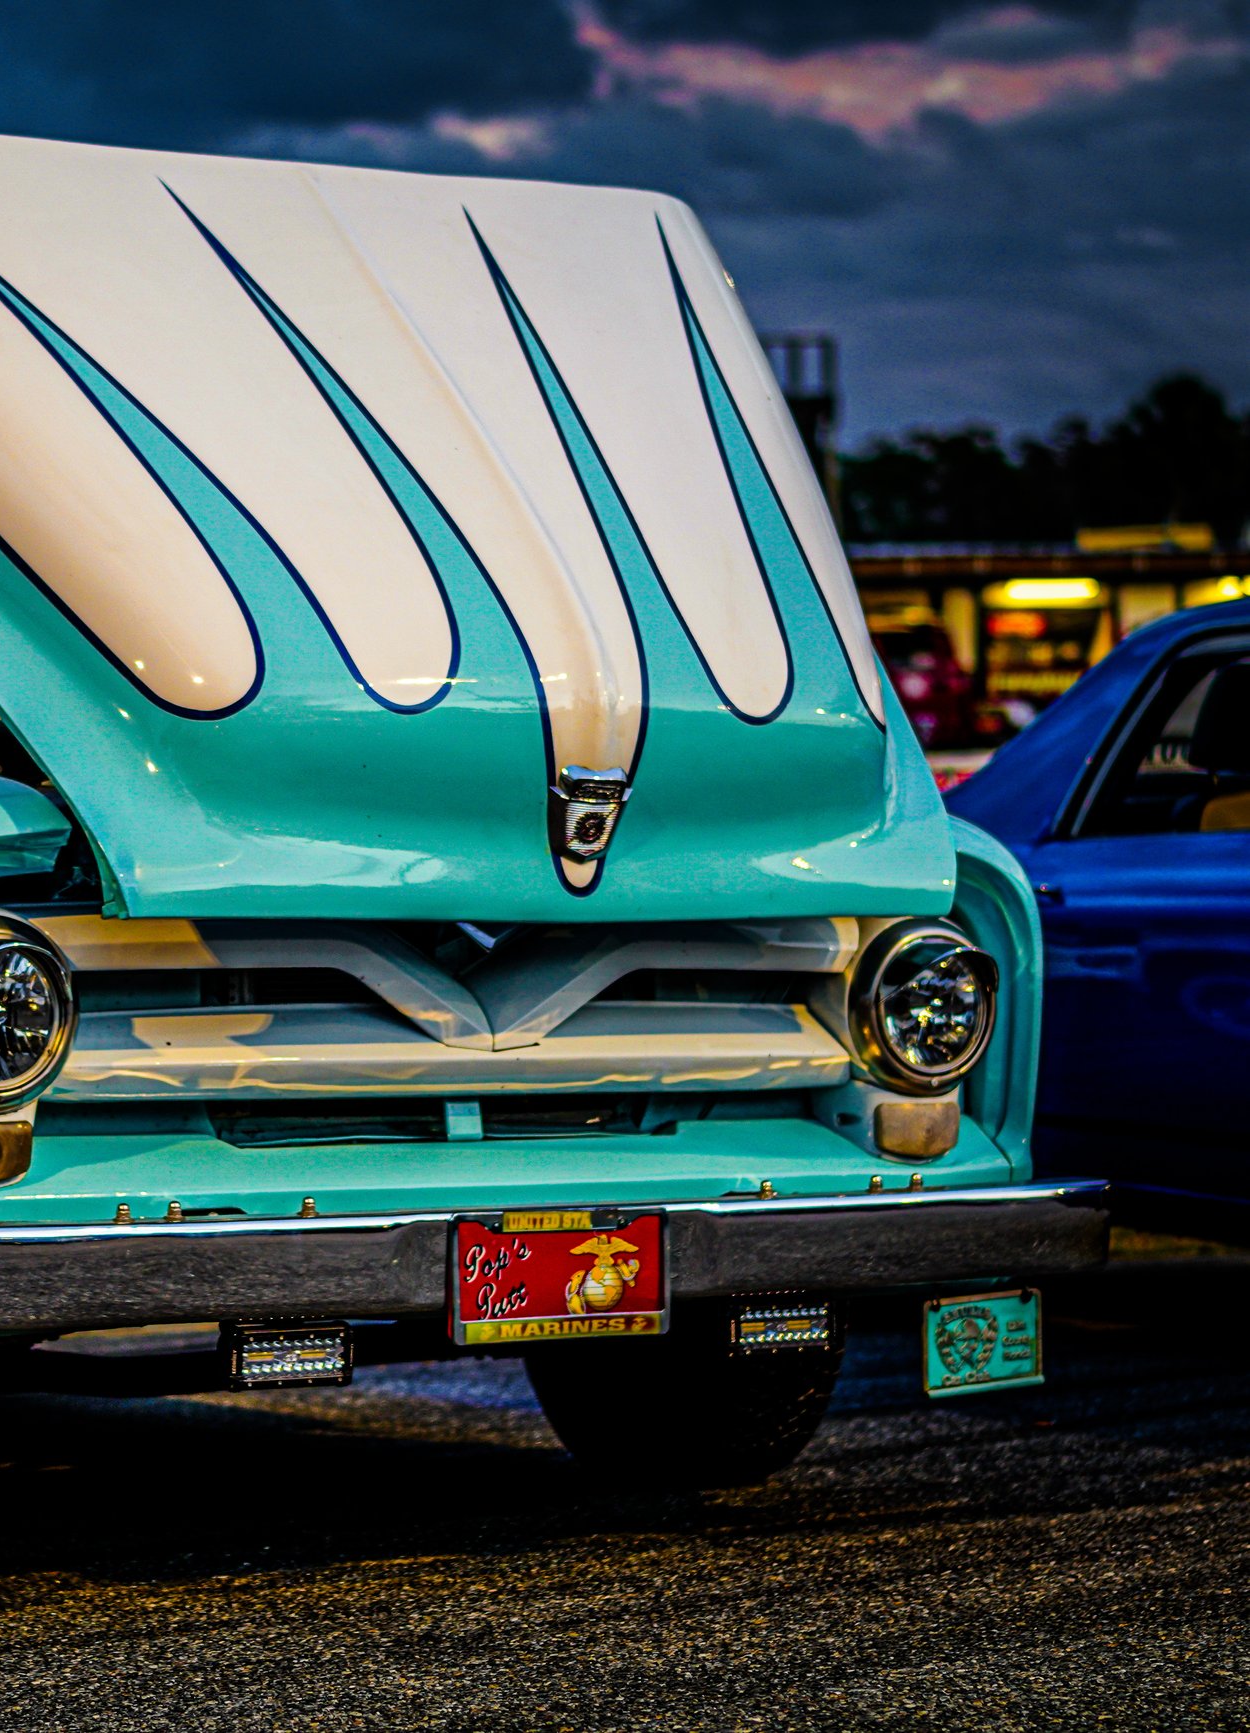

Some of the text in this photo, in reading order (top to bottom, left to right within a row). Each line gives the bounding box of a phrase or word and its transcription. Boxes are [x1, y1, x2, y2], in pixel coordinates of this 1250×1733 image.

[508, 1213, 559, 1230] UNITED
[464, 1238, 533, 1284] Pop's
[500, 1317, 626, 1338] MARINES
